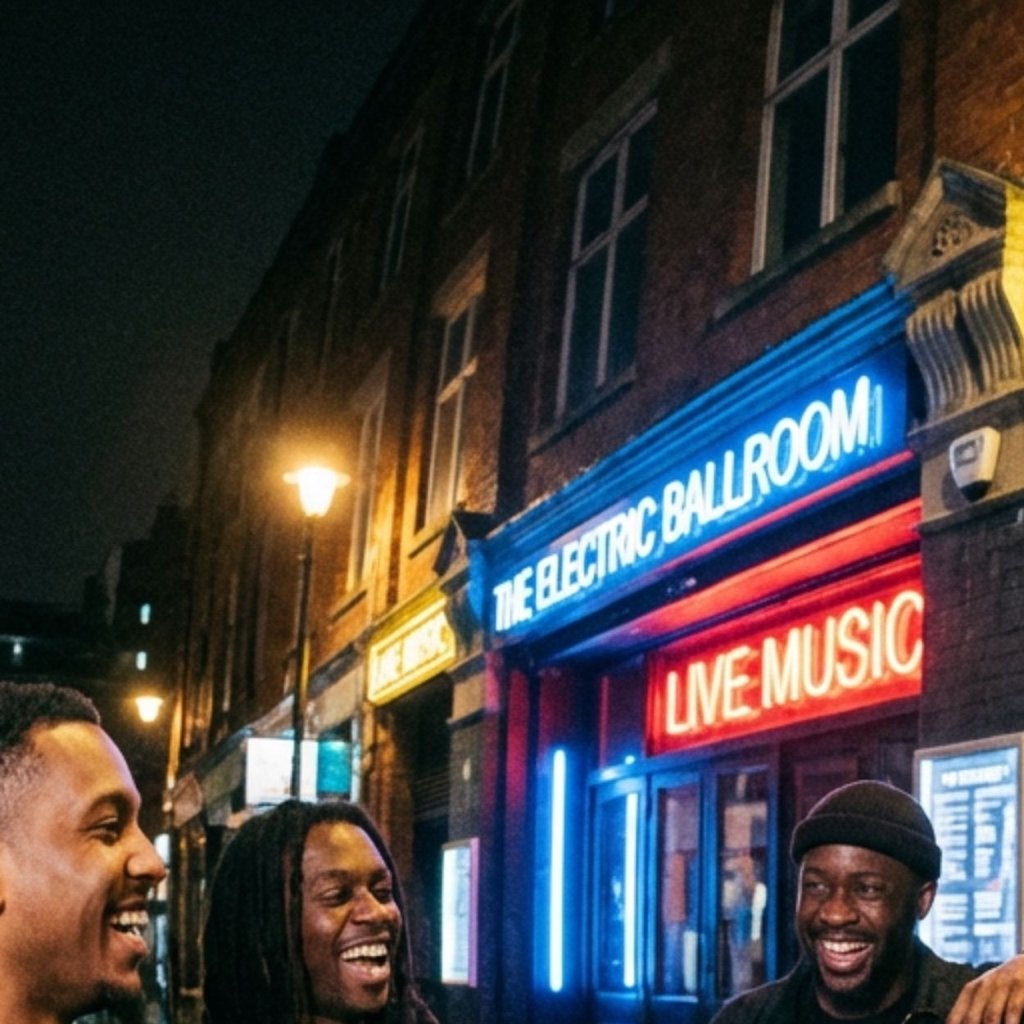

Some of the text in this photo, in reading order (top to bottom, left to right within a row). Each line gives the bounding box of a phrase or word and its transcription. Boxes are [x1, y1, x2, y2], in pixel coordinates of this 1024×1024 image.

[492, 374, 870, 632] THE ELECTRIC BALLROOM
[664, 588, 925, 736] LIVE MUSIC
